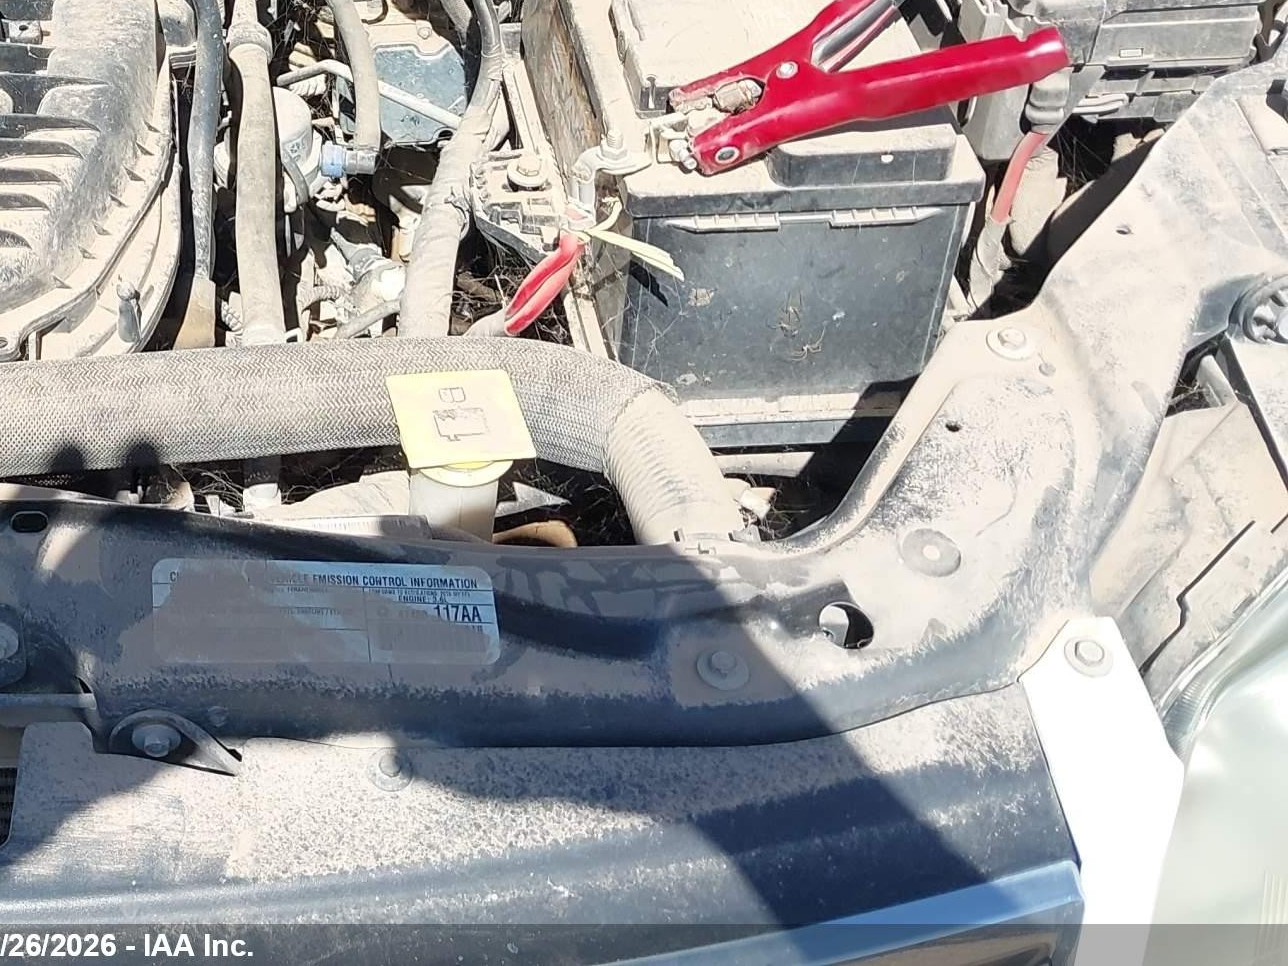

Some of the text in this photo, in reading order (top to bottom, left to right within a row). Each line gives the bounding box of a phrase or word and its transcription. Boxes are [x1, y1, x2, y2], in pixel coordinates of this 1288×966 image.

[313, 574, 359, 586] EMISSION
[362, 576, 407, 587] CONTROL
[410, 577, 478, 589] INFORMATION
